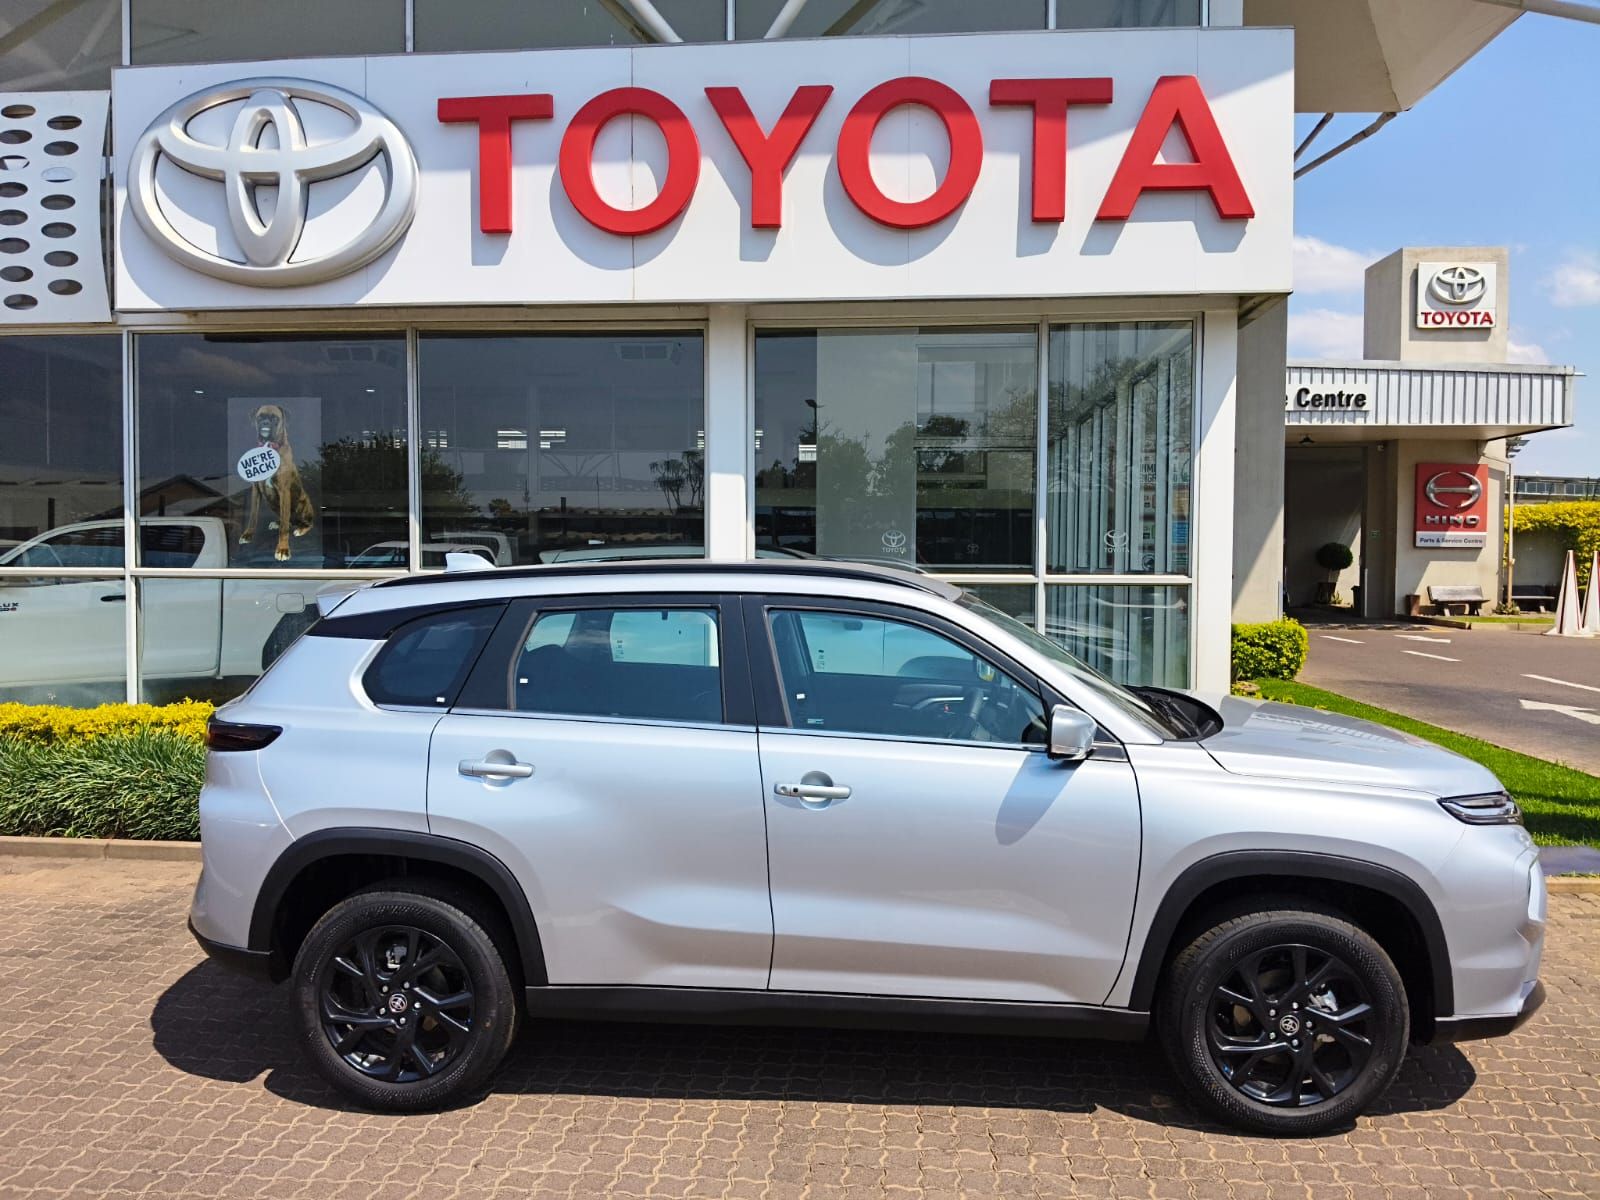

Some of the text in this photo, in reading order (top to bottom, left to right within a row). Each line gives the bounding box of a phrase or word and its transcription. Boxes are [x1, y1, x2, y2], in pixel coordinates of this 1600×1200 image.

[437, 75, 1254, 236] TOYOTA
[1420, 311, 1493, 325] TOYOTA
[1296, 387, 1367, 408] Centre
[240, 449, 275, 470] WE'RE
[245, 459, 277, 479] BACK!
[1425, 515, 1480, 525] HINO
